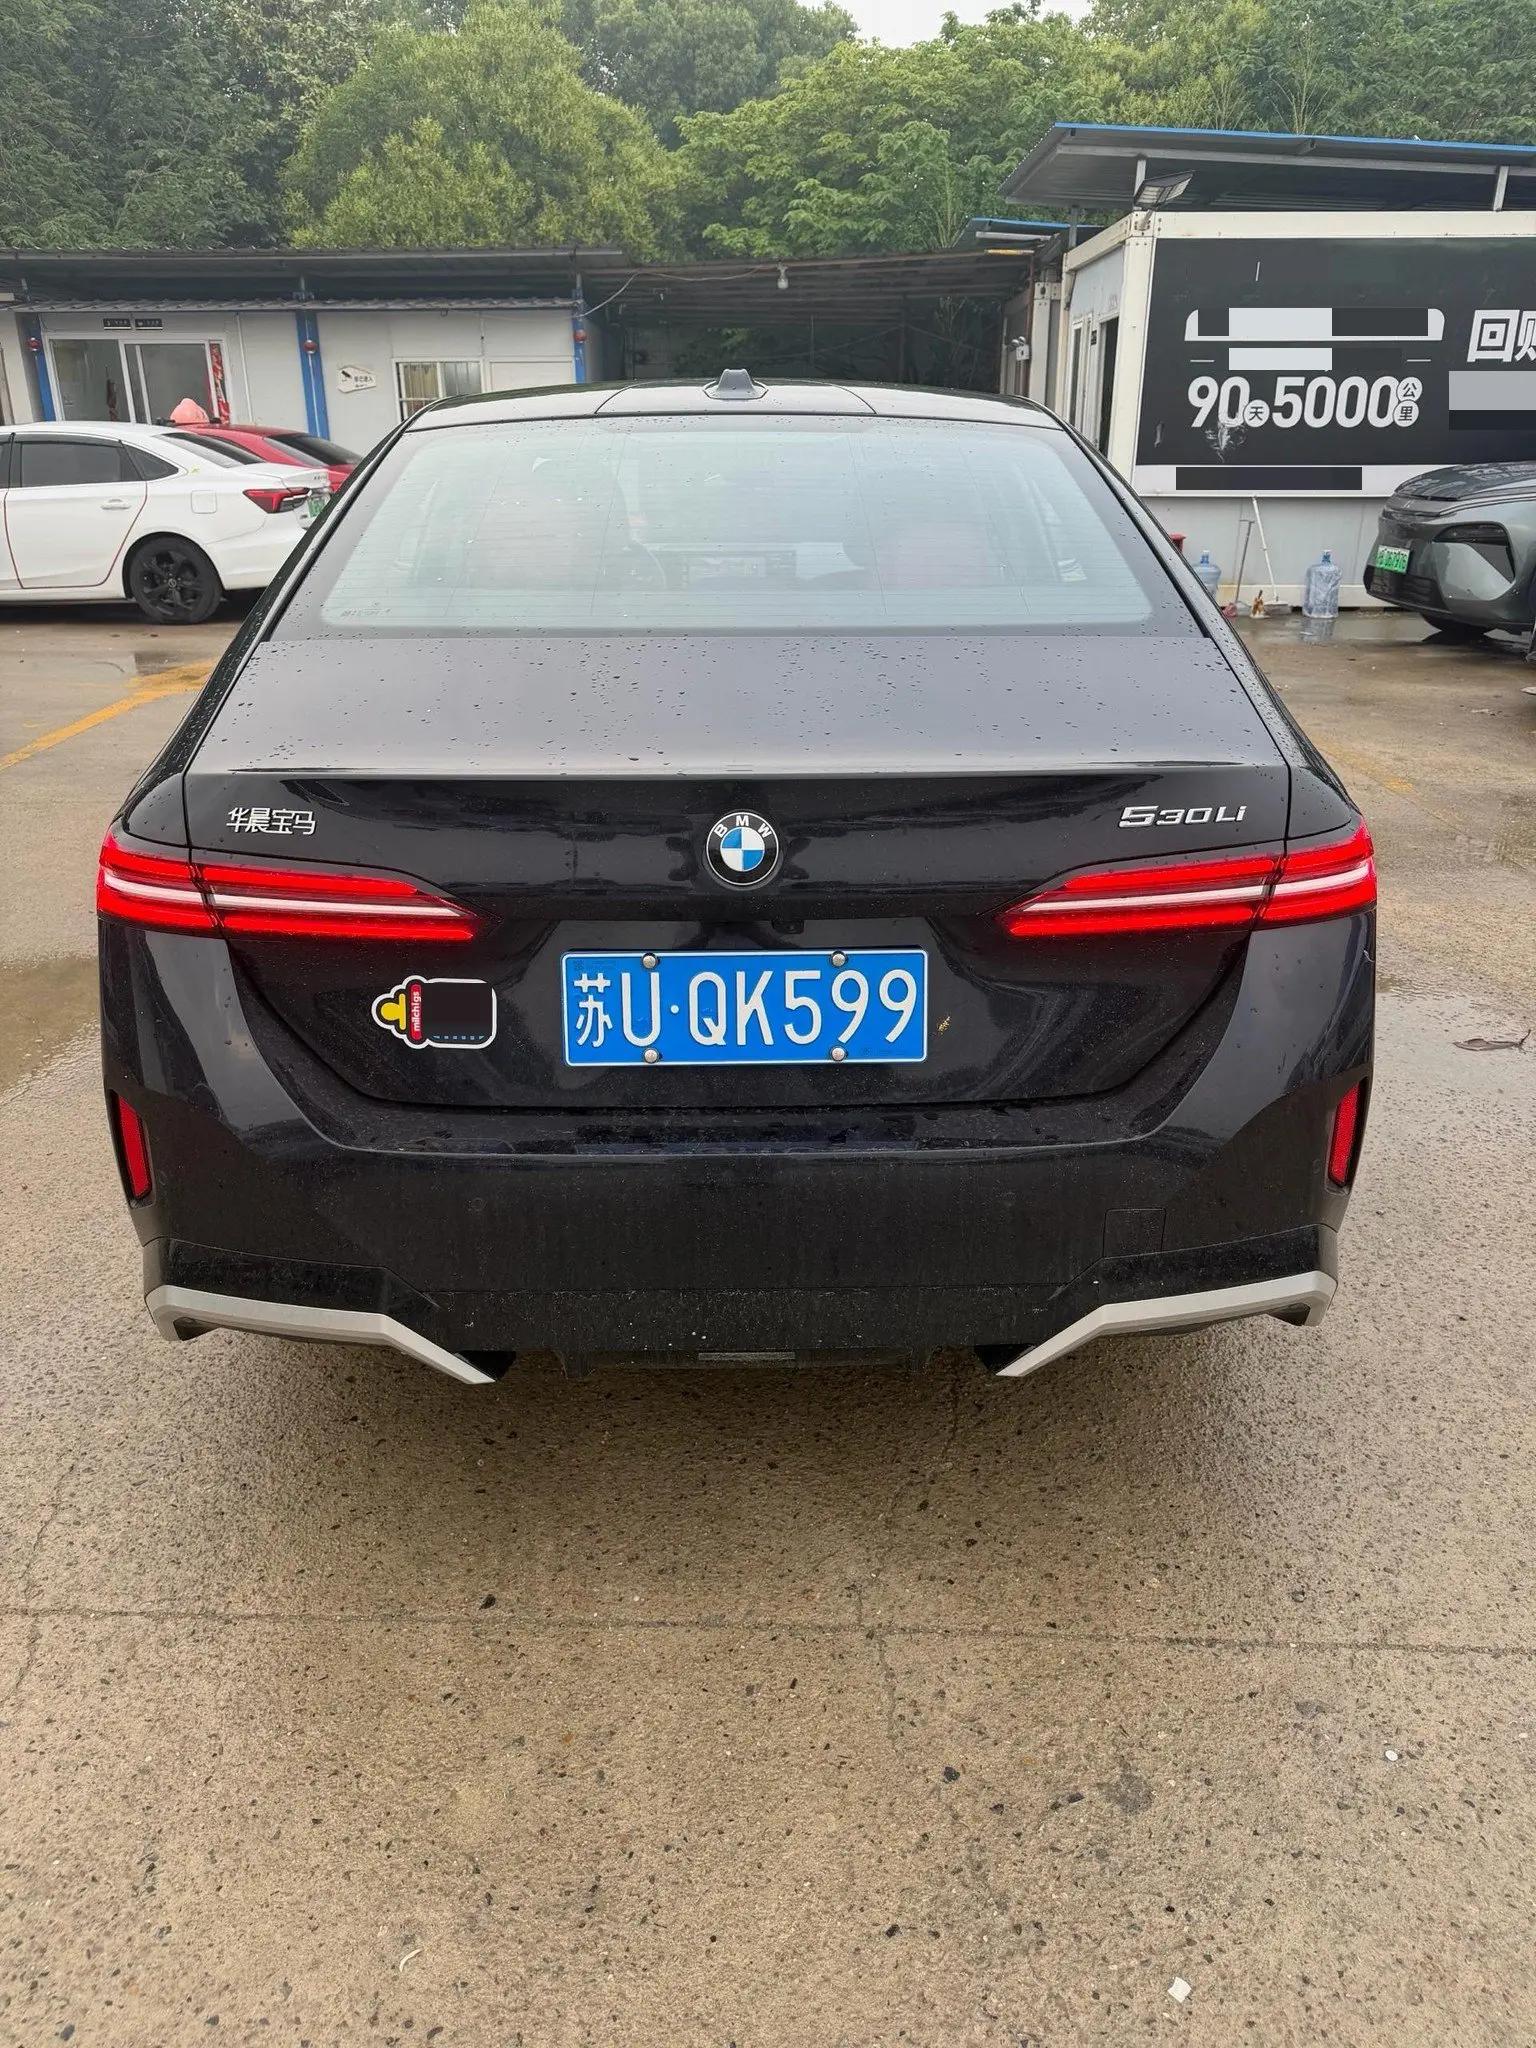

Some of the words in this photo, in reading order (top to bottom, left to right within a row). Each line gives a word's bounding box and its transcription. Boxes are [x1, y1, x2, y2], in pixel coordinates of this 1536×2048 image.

[226, 807, 316, 835] 华晨宝马
[714, 815, 773, 838] BMW
[1118, 805, 1248, 828] 530Li
